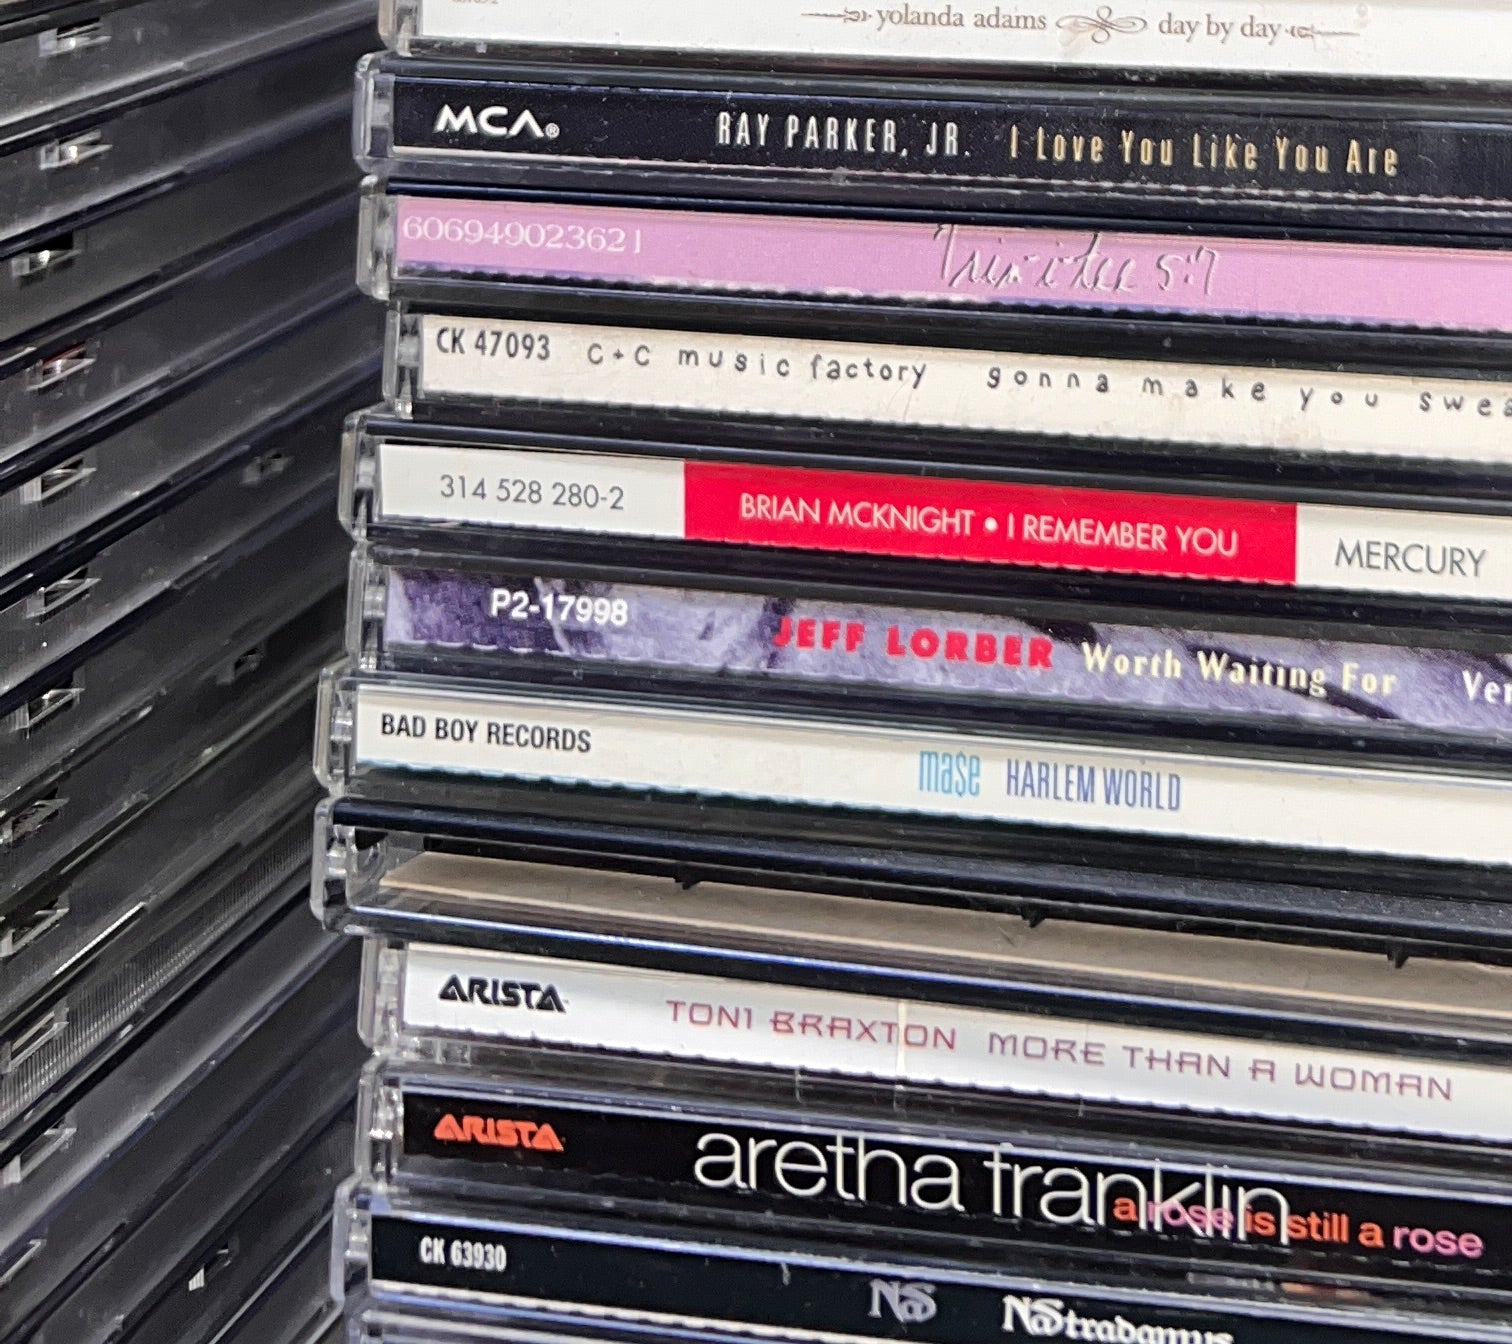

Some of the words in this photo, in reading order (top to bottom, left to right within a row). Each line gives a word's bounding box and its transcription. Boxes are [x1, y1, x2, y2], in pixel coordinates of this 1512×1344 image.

[876, 3, 965, 31] yolanda
[973, 7, 1046, 31] adams
[1158, 13, 1199, 42] day
[1206, 14, 1234, 42] by
[1239, 16, 1282, 43] day
[715, 112, 770, 146] RAY
[1037, 128, 1104, 164] Love
[1121, 130, 1172, 166] You
[1192, 133, 1258, 170] Like
[1275, 135, 1330, 173] You
[1347, 139, 1399, 174] Are
[402, 215, 642, 254] 606949023621
[435, 327, 468, 354] CK
[473, 329, 550, 361] 47093
[986, 367, 1110, 393] gonna
[1141, 374, 1266, 403] make
[1299, 386, 1379, 411] you
[440, 475, 487, 503] 314
[495, 478, 542, 505] 528
[551, 481, 625, 511] 280-2
[740, 493, 821, 525] BRIAN
[1023, 515, 1167, 552] REMEMBER
[1175, 526, 1238, 558] YOU
[1335, 539, 1489, 578] MERCURY
[774, 615, 864, 653] JEFF
[886, 623, 1052, 669] LORBER
[1081, 640, 1182, 681] Worth
[1198, 650, 1327, 694] Waiting
[1341, 662, 1396, 694] For
[381, 713, 426, 738] BAD
[434, 717, 478, 743] BOY
[486, 723, 591, 754] RECORDS
[1006, 760, 1096, 804] HARLEM
[1103, 771, 1181, 812] WORLD
[439, 974, 566, 1013] ARISTA
[666, 999, 752, 1029] TONI
[988, 1031, 1106, 1065] MORE
[1124, 1044, 1230, 1080] THAN
[1295, 1061, 1453, 1101] WOMAN
[433, 1114, 565, 1153] ARISTA
[694, 1131, 966, 1214] aretha
[420, 1236, 446, 1265] CK
[451, 1238, 508, 1272] 63930
[1392, 1225, 1484, 1259] rose
